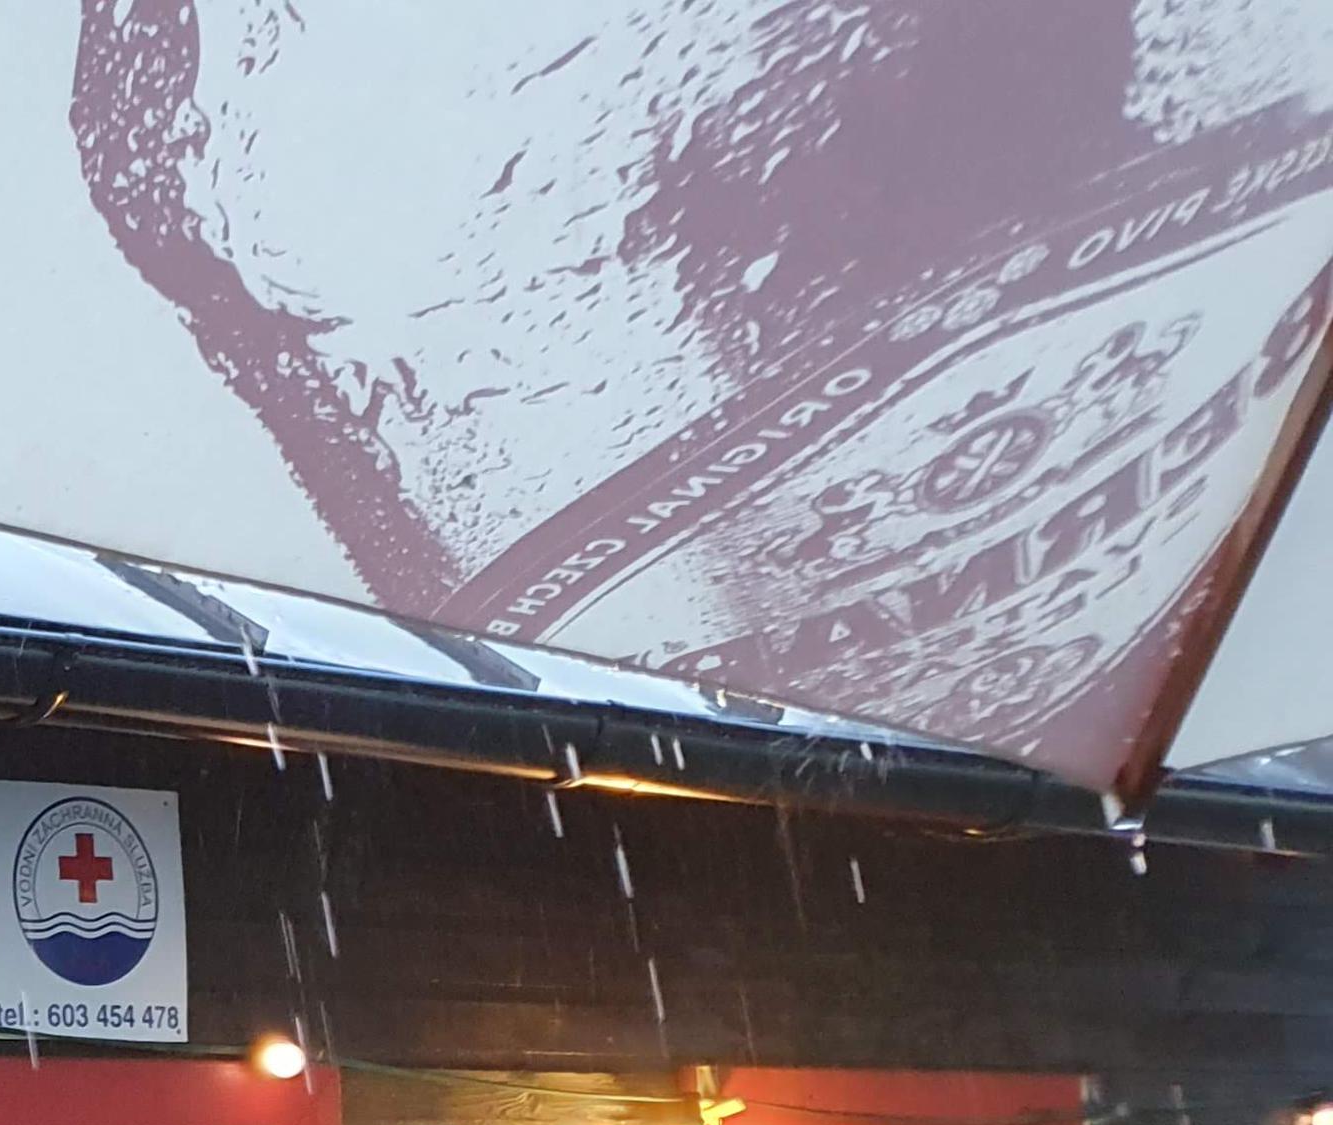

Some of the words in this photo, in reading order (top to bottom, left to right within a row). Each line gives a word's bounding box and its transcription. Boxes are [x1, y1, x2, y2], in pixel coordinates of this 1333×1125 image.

[47, 1003, 88, 1028] 603
[96, 1004, 135, 1028] 454
[142, 1005, 179, 1029] 478
